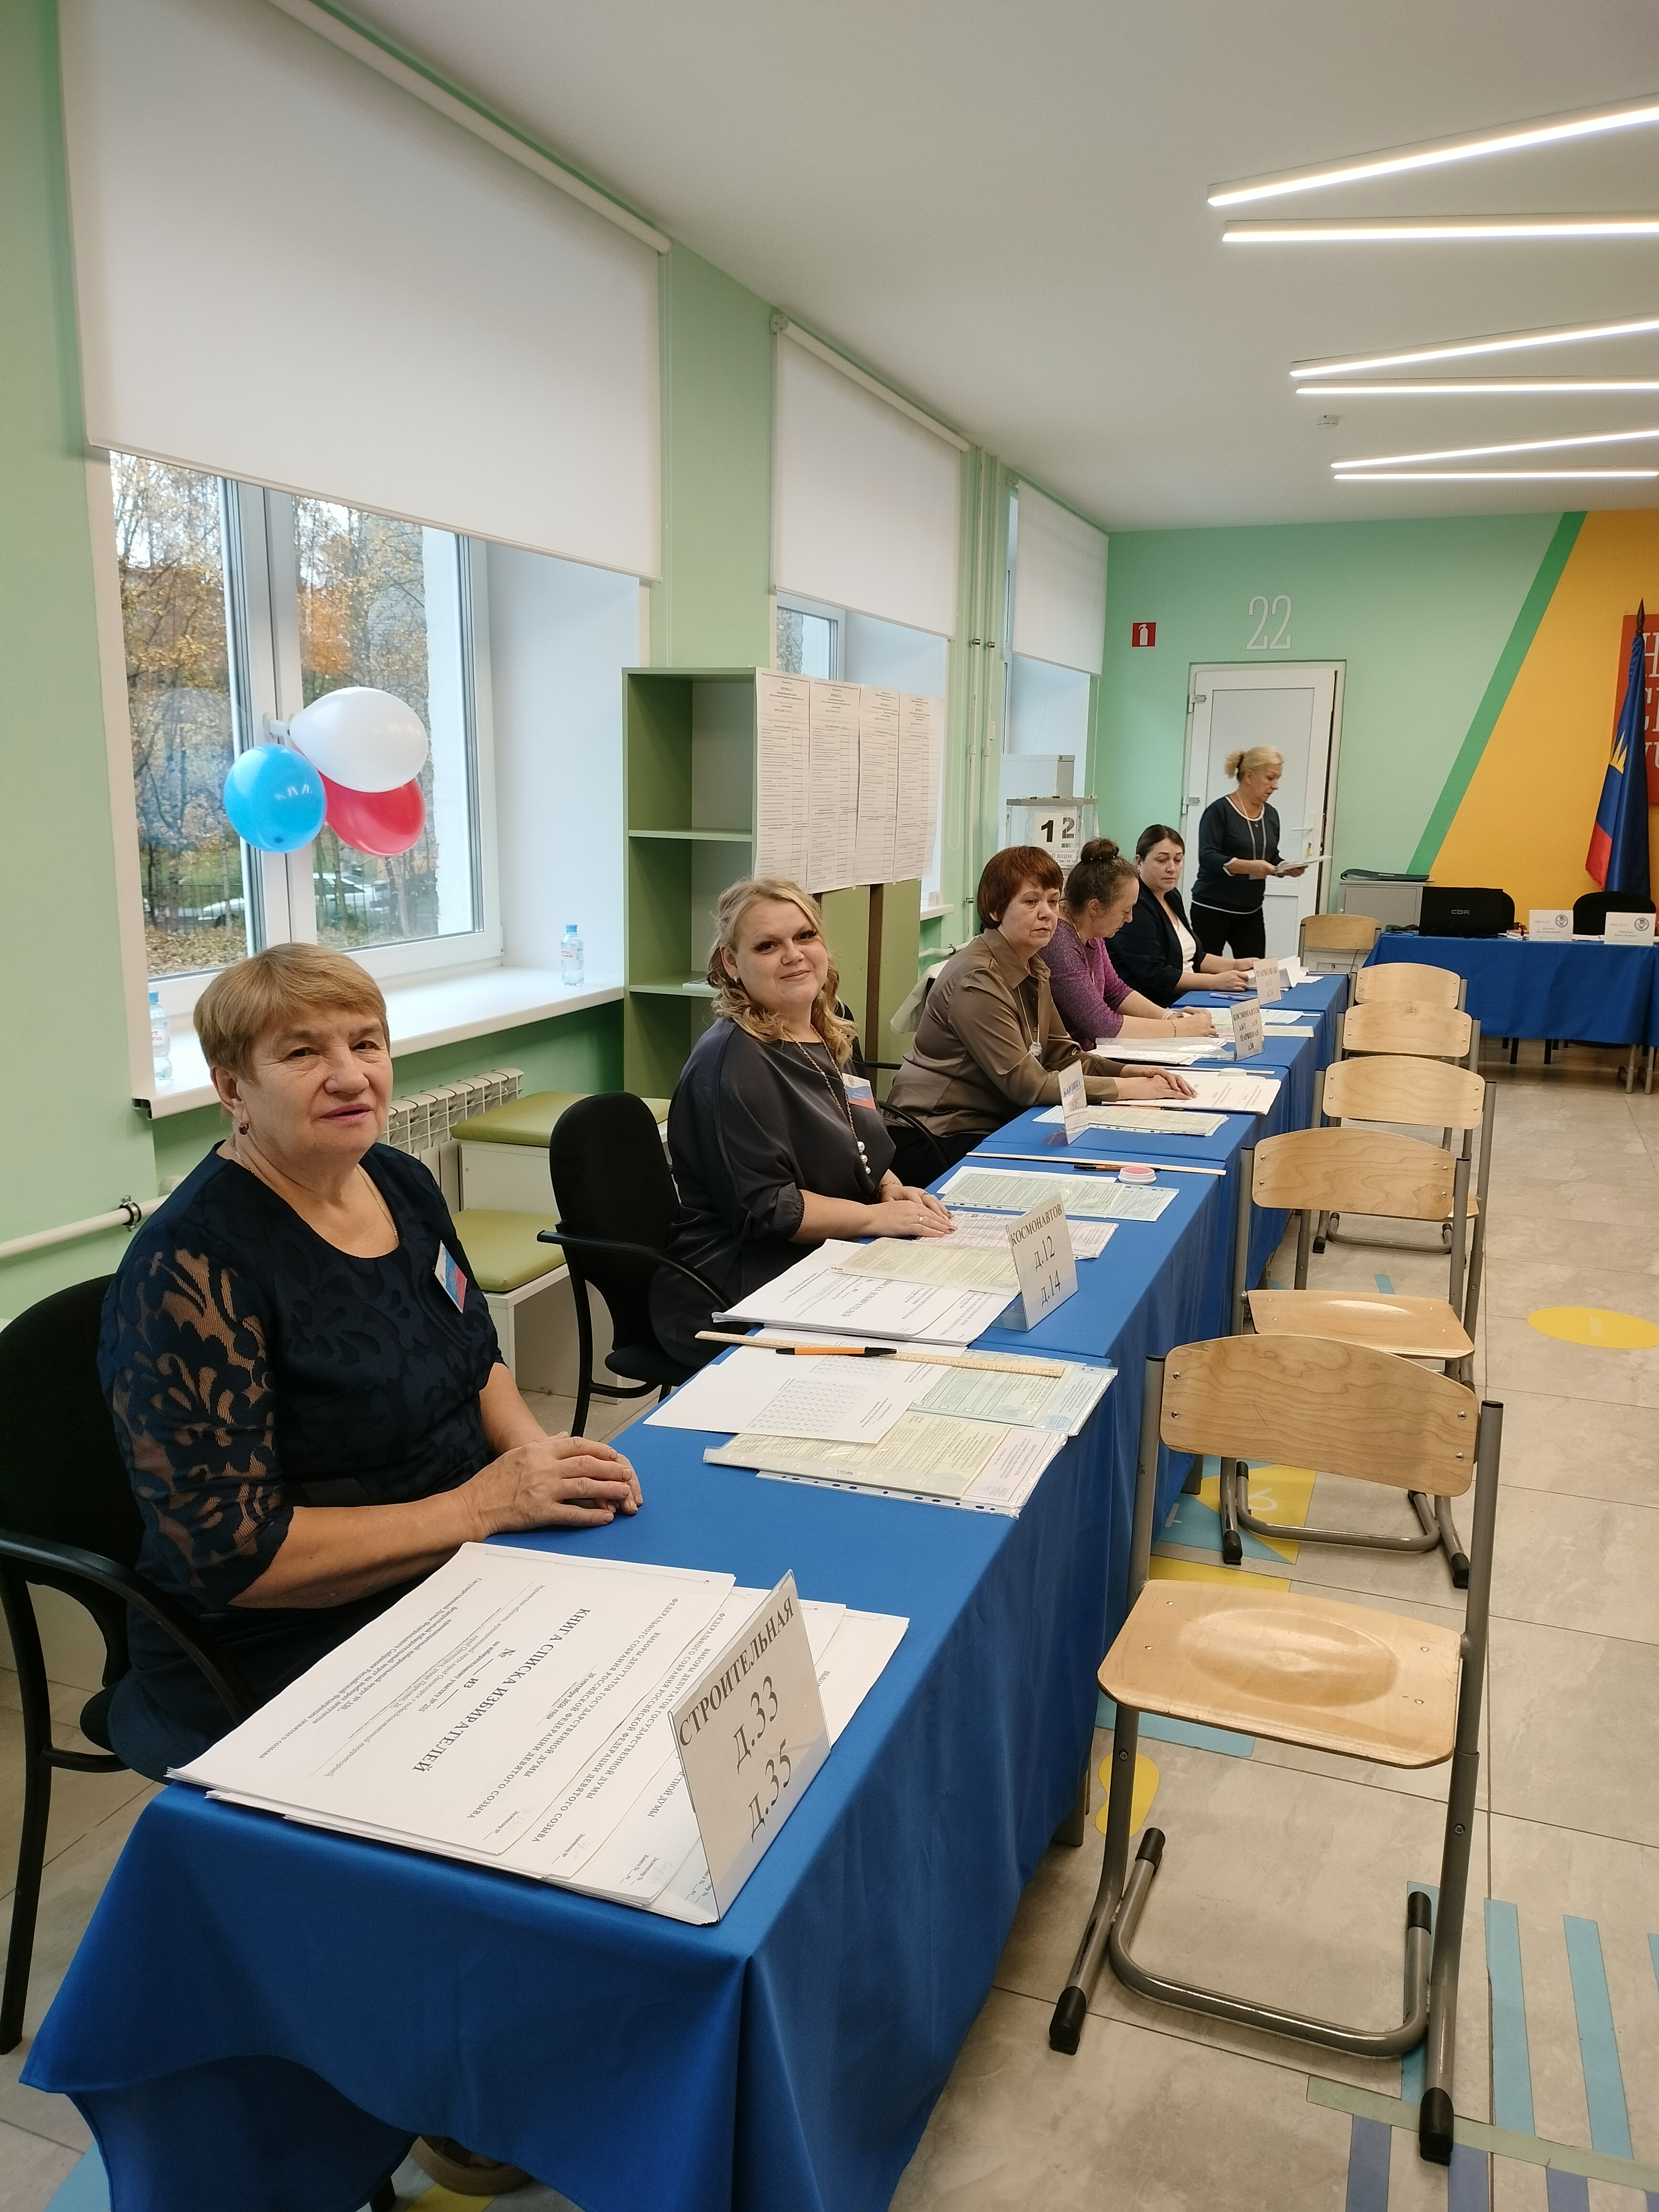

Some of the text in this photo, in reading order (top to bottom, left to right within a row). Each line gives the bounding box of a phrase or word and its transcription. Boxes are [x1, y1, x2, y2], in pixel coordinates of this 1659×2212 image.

[1246, 595, 1292, 650] 22
[1041, 820, 1053, 842] 1
[1256, 967, 1277, 977] ПАРКОВАЯ
[1240, 1029, 1259, 1042] ПАРКОВАЯ
[1010, 1204, 1062, 1246] КОСМОНАВТОВ
[1033, 1236, 1055, 1272] д.12
[840, 1280, 894, 1316] ПИСКА ИЗБИРАТЕЛЕЙ
[1041, 1270, 1061, 1307] д.14
[517, 1584, 546, 1606] Мурманская
[424, 1606, 459, 1632] федеральный
[498, 1606, 522, 1623] область,
[547, 1608, 592, 1642] КНИГА
[636, 1598, 680, 1639] ФЕДЕРАЛЬНОГО
[385, 1632, 428, 1663] избирательный
[412, 1619, 453, 1650] одномандатный
[464, 1635, 480, 1646] город
[466, 1623, 502, 1653] муниципальный
[634, 1632, 661, 1656] ВЫБОРЫ
[372, 1650, 416, 1682] избирательный
[440, 1662, 457, 1674] город
[452, 1647, 495, 1679] избирательному
[453, 1653, 469, 1663] округ
[496, 1648, 517, 1658] №
[501, 1644, 556, 1686] СПИСКА
[608, 1640, 641, 1671] СОБРАНИЯ
[257, 1578, 484, 1759] Государственной Думы Федерального Собрания Российской Федерации девятого созыва
[369, 1663, 389, 1676] округ
[422, 1668, 440, 1680] улица
[602, 1657, 639, 1692] ДЕПУТАТОВ
[679, 1595, 794, 1747] СТРОИТЕЛЬНАЯ
[338, 1681, 366, 1701] выборах
[356, 1682, 376, 1695] округ
[412, 1674, 445, 1699] Оленегорск
[431, 1679, 458, 1698] участку
[565, 1678, 589, 1698] сентября
[569, 1671, 612, 1712] РОССИЙСКОЙ
[310, 1701, 343, 1724] депутатов
[417, 1703, 431, 1712] 255
[544, 1709, 559, 1720] года
[555, 1698, 571, 1709] 2026
[361, 1702, 413, 1743] подведомственной
[410, 1687, 509, 1773] ИЗБИРАТЕЛЕЙ
[531, 1612, 727, 1843] ФЕДЕРАЛЬНОГО СОБРАНИЯ РОССИЙСКОЙ ФЕДЕРАЦИИ ДЕВЯТОГО СОЗЫВА
[531, 1712, 574, 1751] ФЕДЕРАЦИИ
[543, 1692, 607, 1754] ГОСУДАРСТВЕННОЙ
[585, 1648, 711, 1799] ВЫБОРЫ ДЕПУТАТОВ ГОСУДАРСТВЕННОЙ ДУМЫ
[322, 1742, 366, 1778] территорией,
[496, 1751, 536, 1789] ДЕВЯТОГО
[522, 1754, 548, 1777] ДУМЫ
[465, 1790, 500, 1819] СОЗЫВА
[646, 1795, 669, 1817] ДУМЫ
